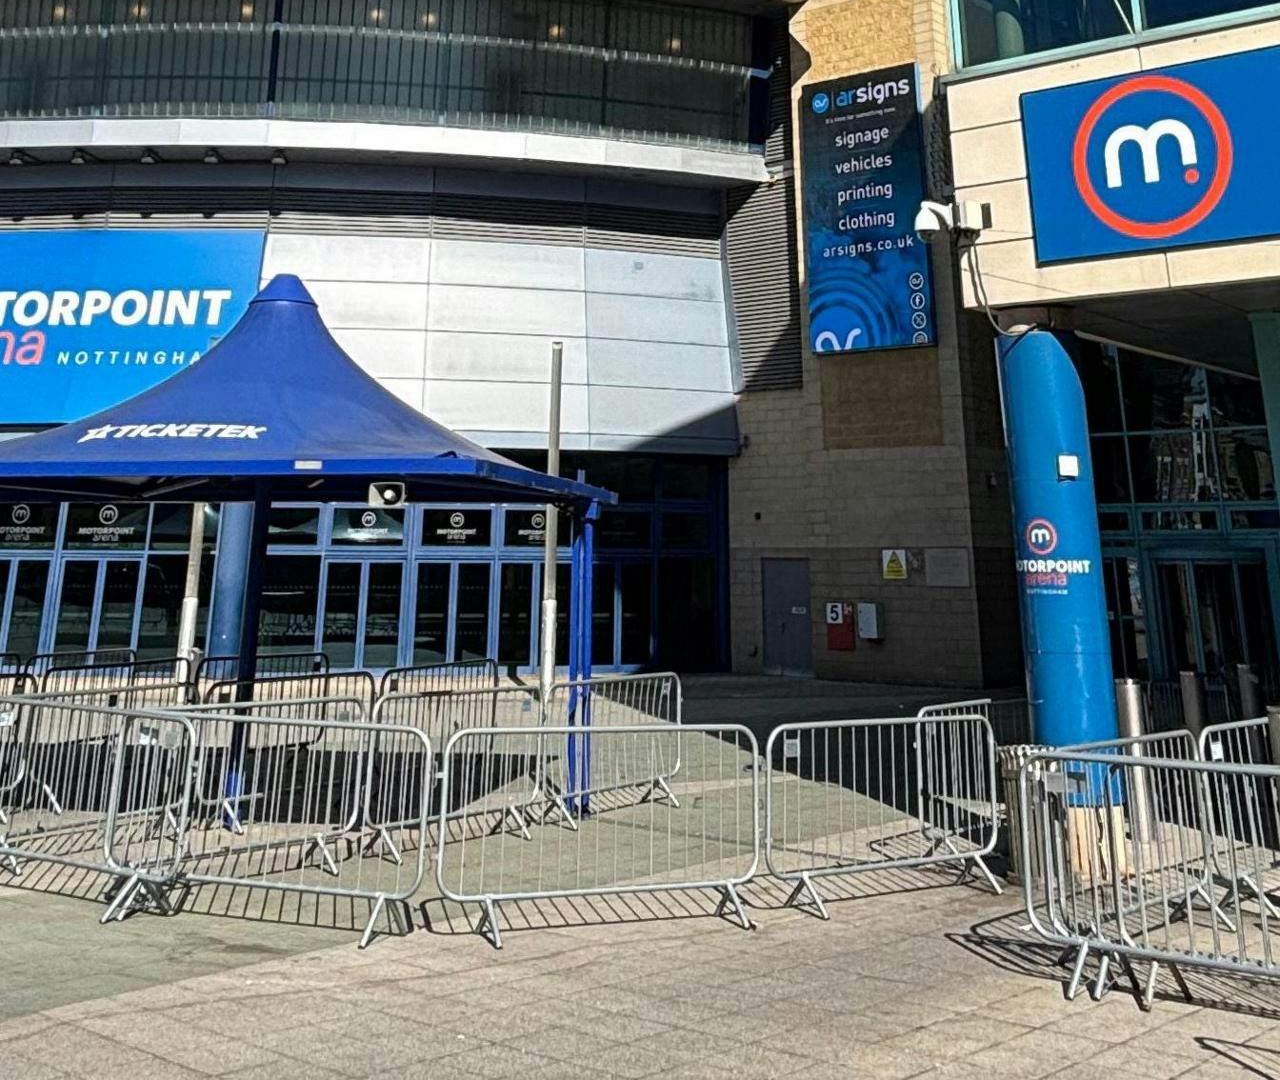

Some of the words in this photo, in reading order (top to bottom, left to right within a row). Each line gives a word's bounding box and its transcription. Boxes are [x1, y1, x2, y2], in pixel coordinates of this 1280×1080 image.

[836, 79, 910, 107] arsigns
[835, 127, 889, 148] signage
[835, 154, 892, 174] vehicles
[837, 183, 893, 206] printing
[838, 211, 895, 230] clothing
[823, 235, 914, 257] arsigns.co.uk
[57, 351, 201, 366] NOTTINGHA
[113, 423, 268, 439] TICKETEK
[78, 526, 136, 535] MOTORPOINT
[830, 605, 839, 621] 5
